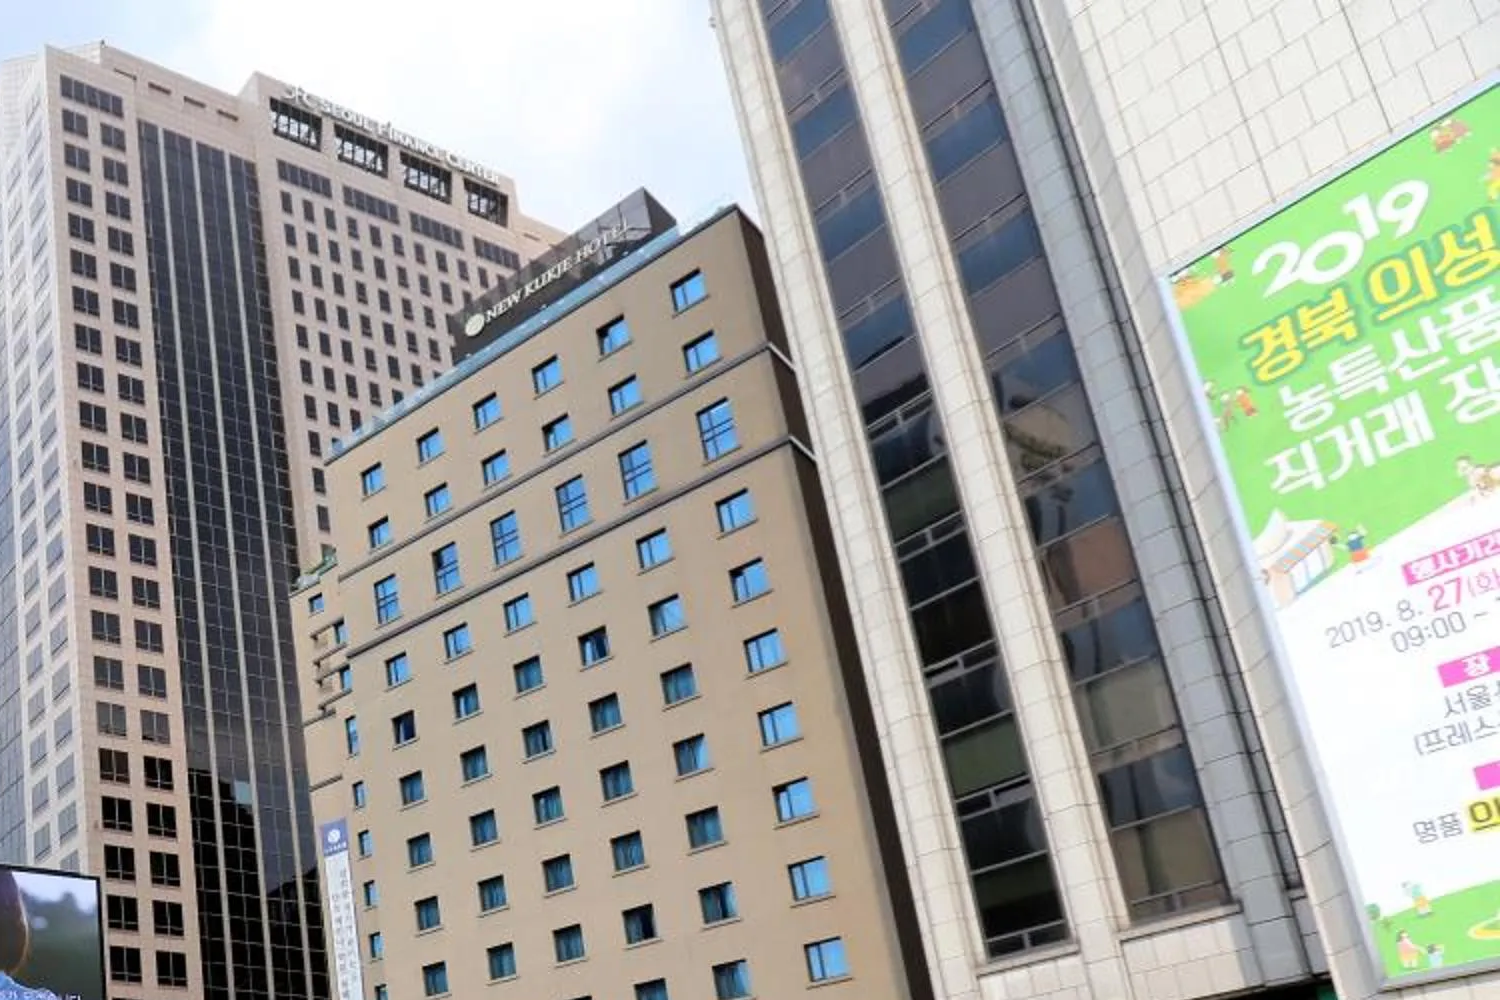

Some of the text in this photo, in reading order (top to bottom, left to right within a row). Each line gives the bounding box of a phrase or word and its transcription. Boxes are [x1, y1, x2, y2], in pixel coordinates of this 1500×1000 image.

[486, 216, 628, 322] NEW KUKJE HOTEL
[1252, 180, 1429, 298] 2019
[1242, 212, 1500, 383] 경북 의성
[1279, 285, 1500, 433] 농특산품
[1264, 389, 1436, 495] 직거래
[1325, 611, 1392, 648] 2019.
[1397, 599, 1424, 622] 8.
[1390, 611, 1466, 652] 09:00
[1444, 680, 1500, 719] 서울
[1413, 812, 1464, 844] 명품
